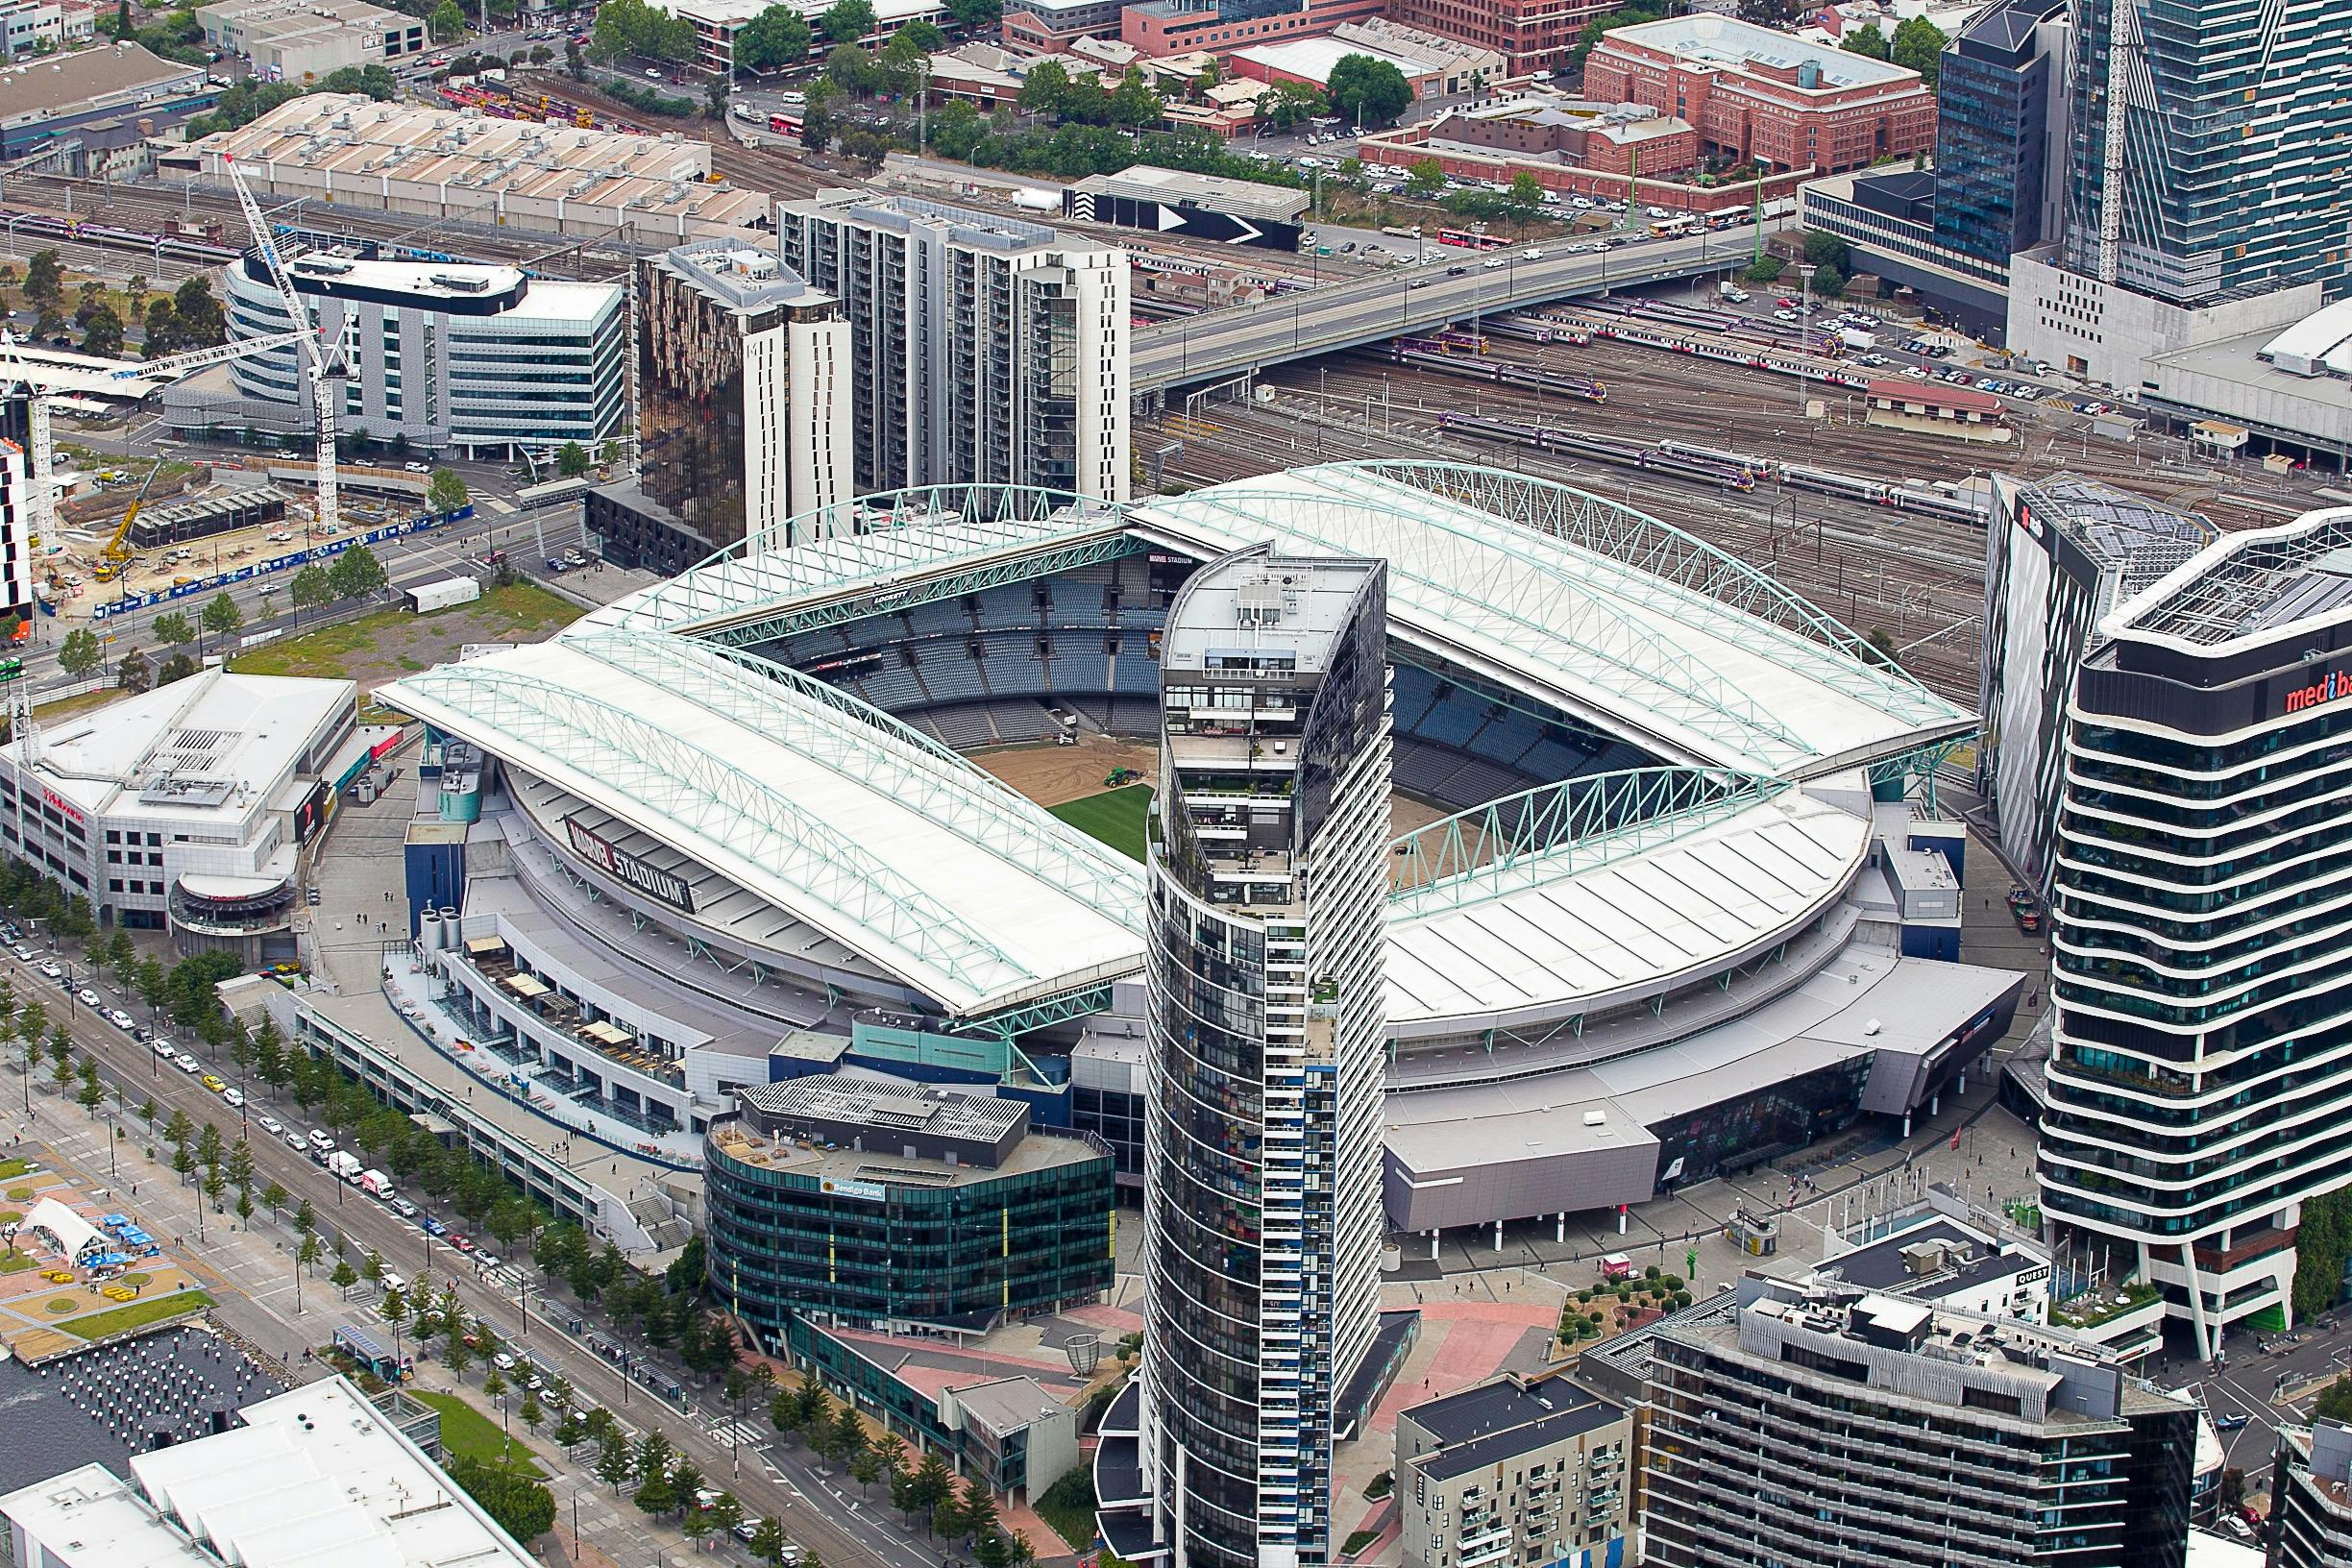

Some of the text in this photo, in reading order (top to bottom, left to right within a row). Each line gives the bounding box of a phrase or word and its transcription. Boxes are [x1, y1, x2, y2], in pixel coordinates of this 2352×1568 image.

[569, 822, 685, 905] MARVEL STADIUM
[834, 1184, 883, 1197] Bendigo Bank
[2019, 1268, 2047, 1284] QUEST
